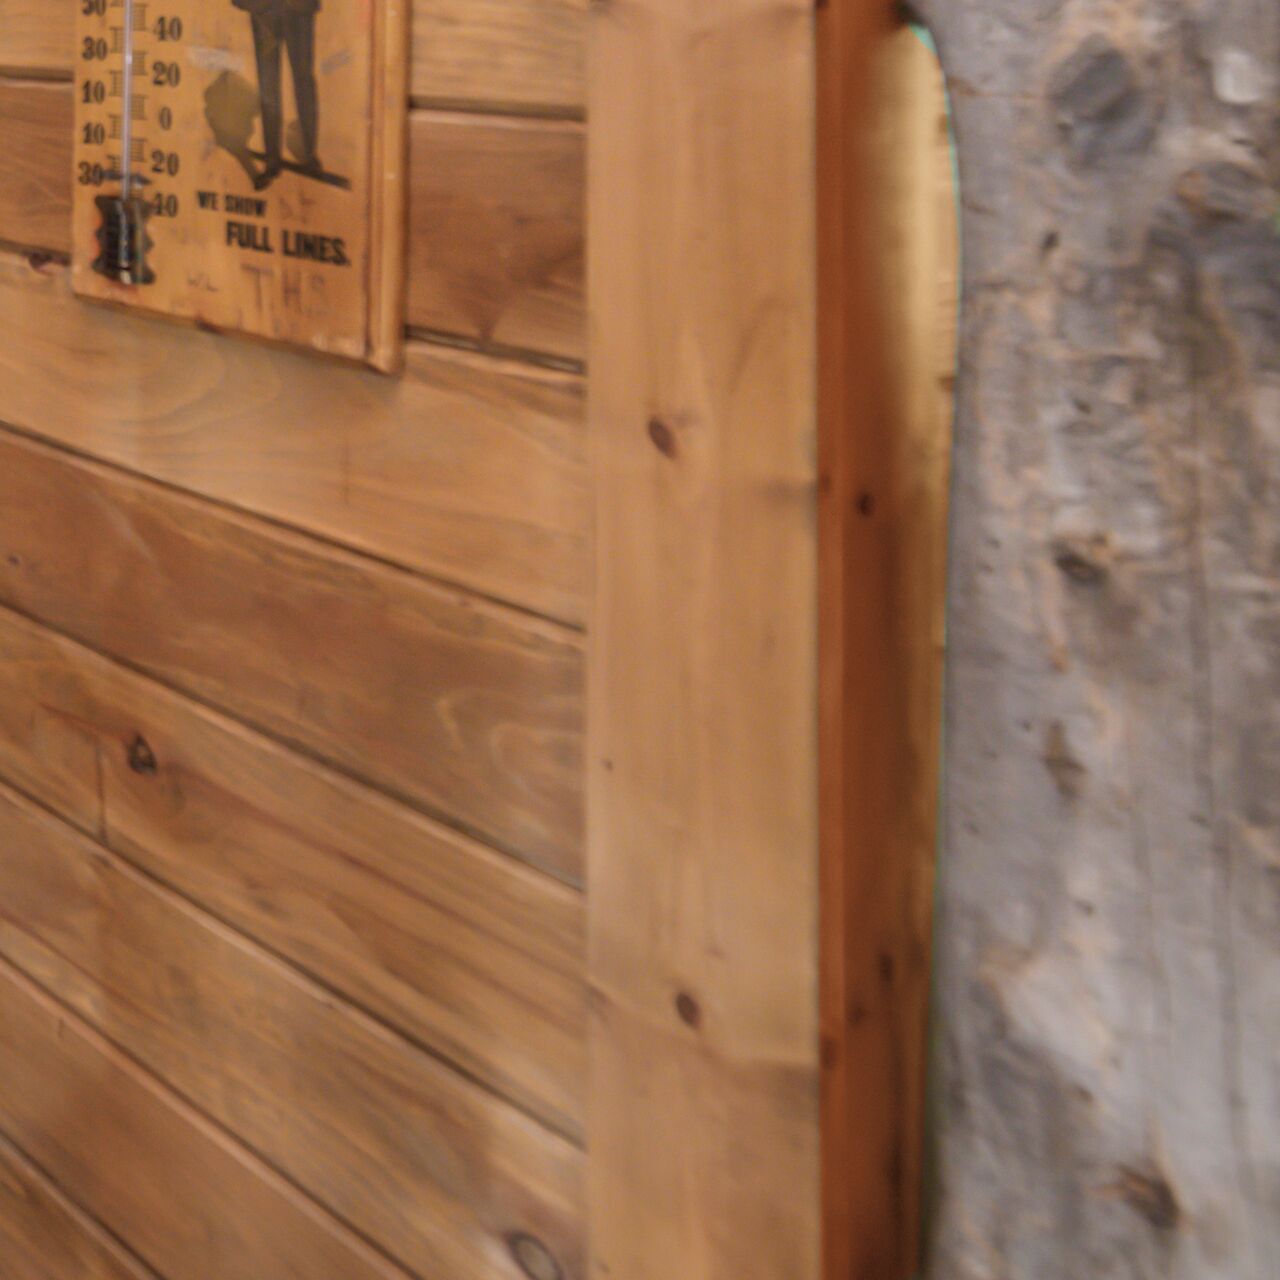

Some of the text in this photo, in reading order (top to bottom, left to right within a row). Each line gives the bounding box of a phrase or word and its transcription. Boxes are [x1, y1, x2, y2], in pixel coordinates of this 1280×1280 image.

[153, 16, 183, 42] 40
[82, 36, 108, 61] 30
[152, 60, 181, 88] 20
[82, 80, 105, 105] 10
[159, 106, 173, 131] 0
[83, 122, 105, 145] 10
[78, 160, 105, 187] 30
[151, 149, 180, 177] 20
[197, 190, 268, 218] WE SHOW
[225, 220, 275, 253] FULL
